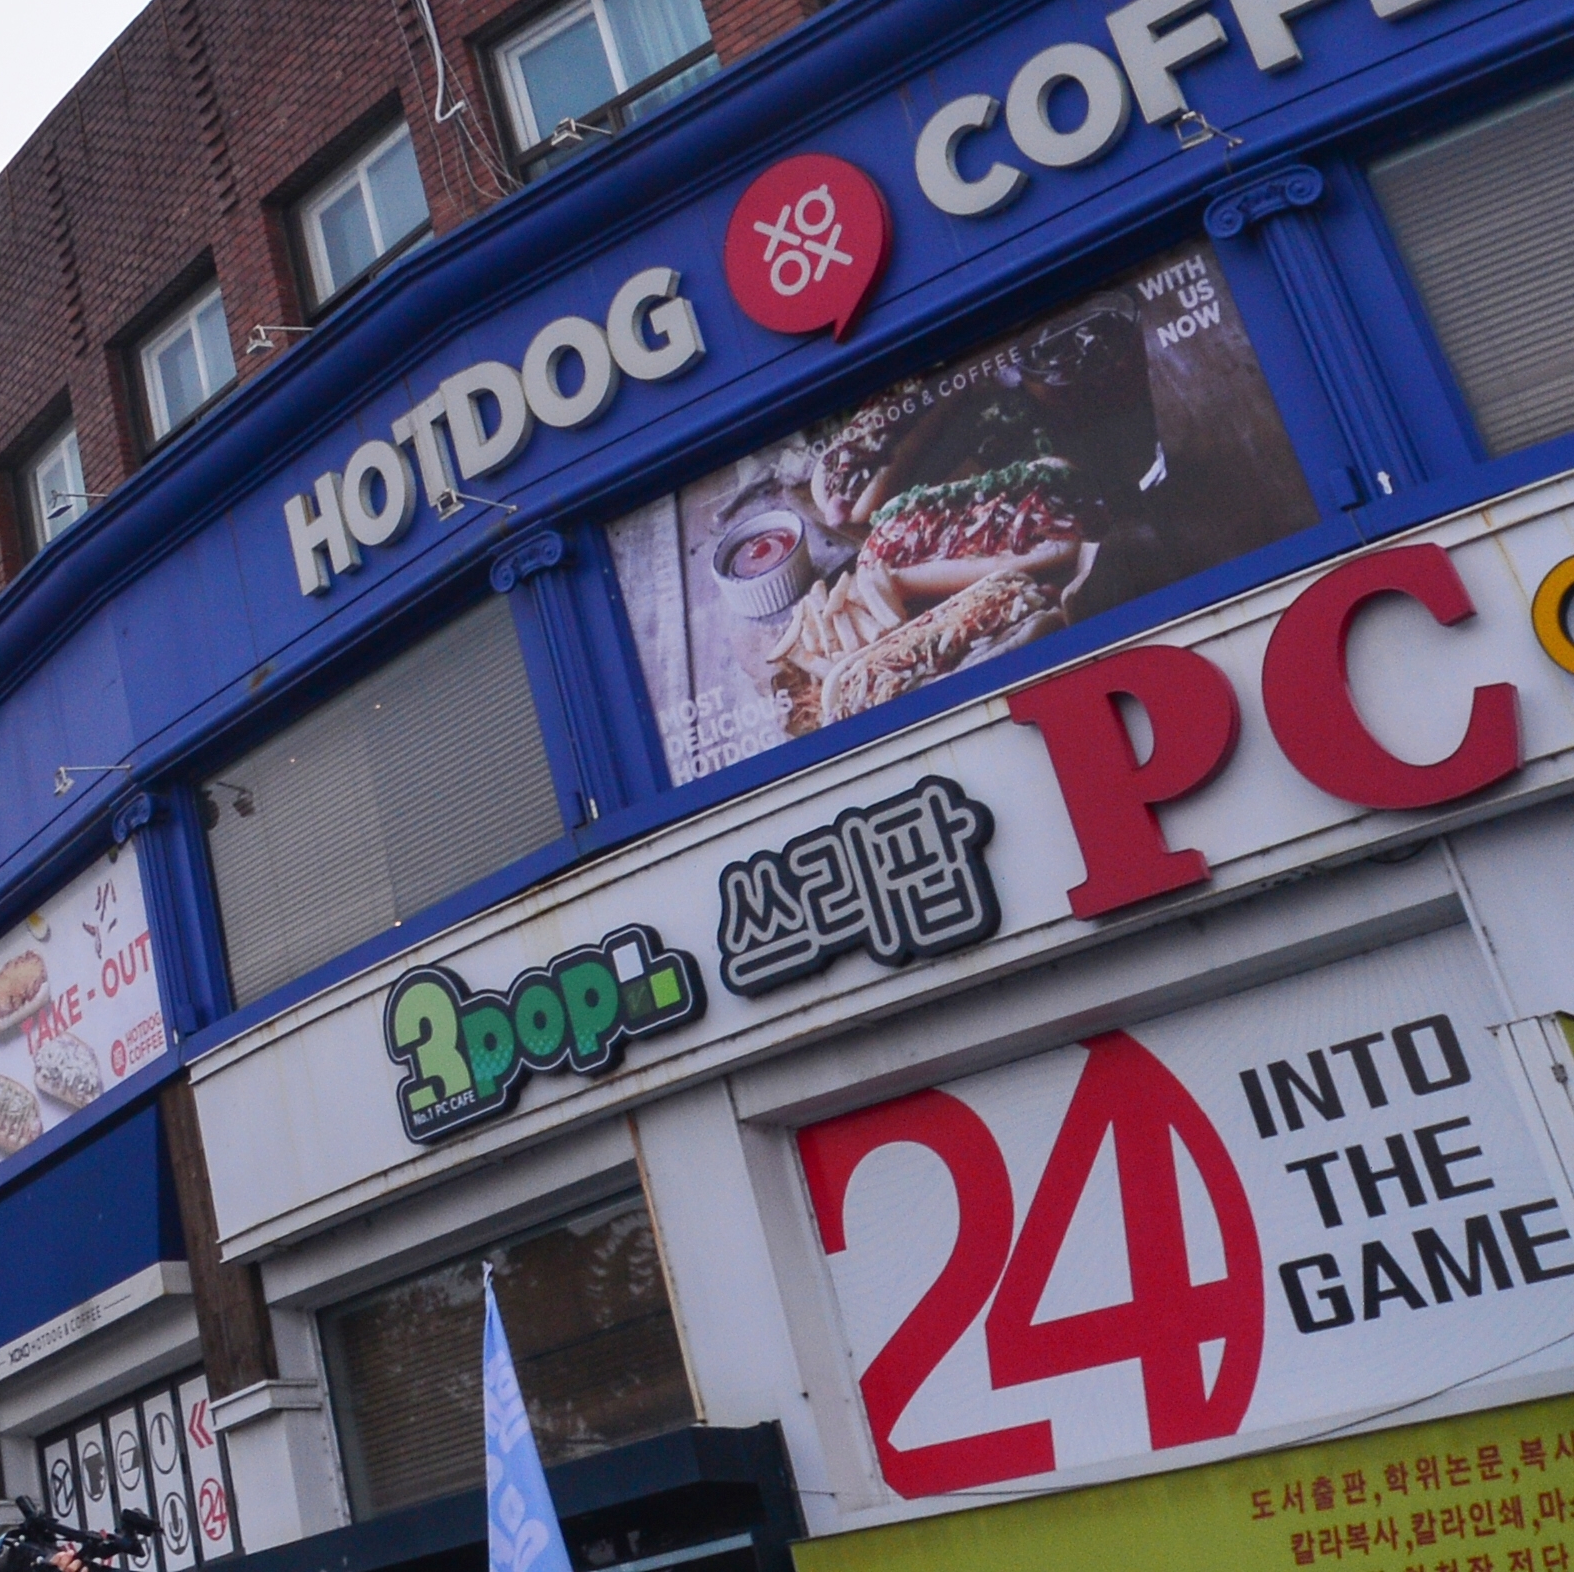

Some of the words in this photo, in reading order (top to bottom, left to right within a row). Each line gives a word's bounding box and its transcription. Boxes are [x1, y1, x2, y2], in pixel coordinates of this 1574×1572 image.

[1137, 254, 1206, 301] WITH
[1177, 278, 1214, 309] US
[1156, 300, 1220, 348] NOW
[939, 346, 1022, 397] COFFEE
[284, 267, 705, 596] HOTDOG
[659, 685, 723, 734] MOST
[666, 689, 793, 759] DELICIOUS
[1007, 542, 1523, 919] PC
[671, 730, 779, 788] HOTDOG
[724, 781, 981, 986] 쓰리팝
[21, 984, 83, 1055] TAKE
[102, 931, 150, 998] OUT
[126, 1011, 163, 1045] HOTDOG
[129, 1030, 164, 1065] COFFEE
[1240, 1014, 1471, 1139] INTO
[413, 1105, 435, 1126] No.1
[436, 1100, 451, 1119] PC
[451, 1089, 476, 1114] CAFE
[1286, 1115, 1494, 1228] THE
[796, 1028, 1264, 1499] 24
[1279, 1198, 1574, 1334] GAME
[71, 1305, 102, 1332] COFFEE
